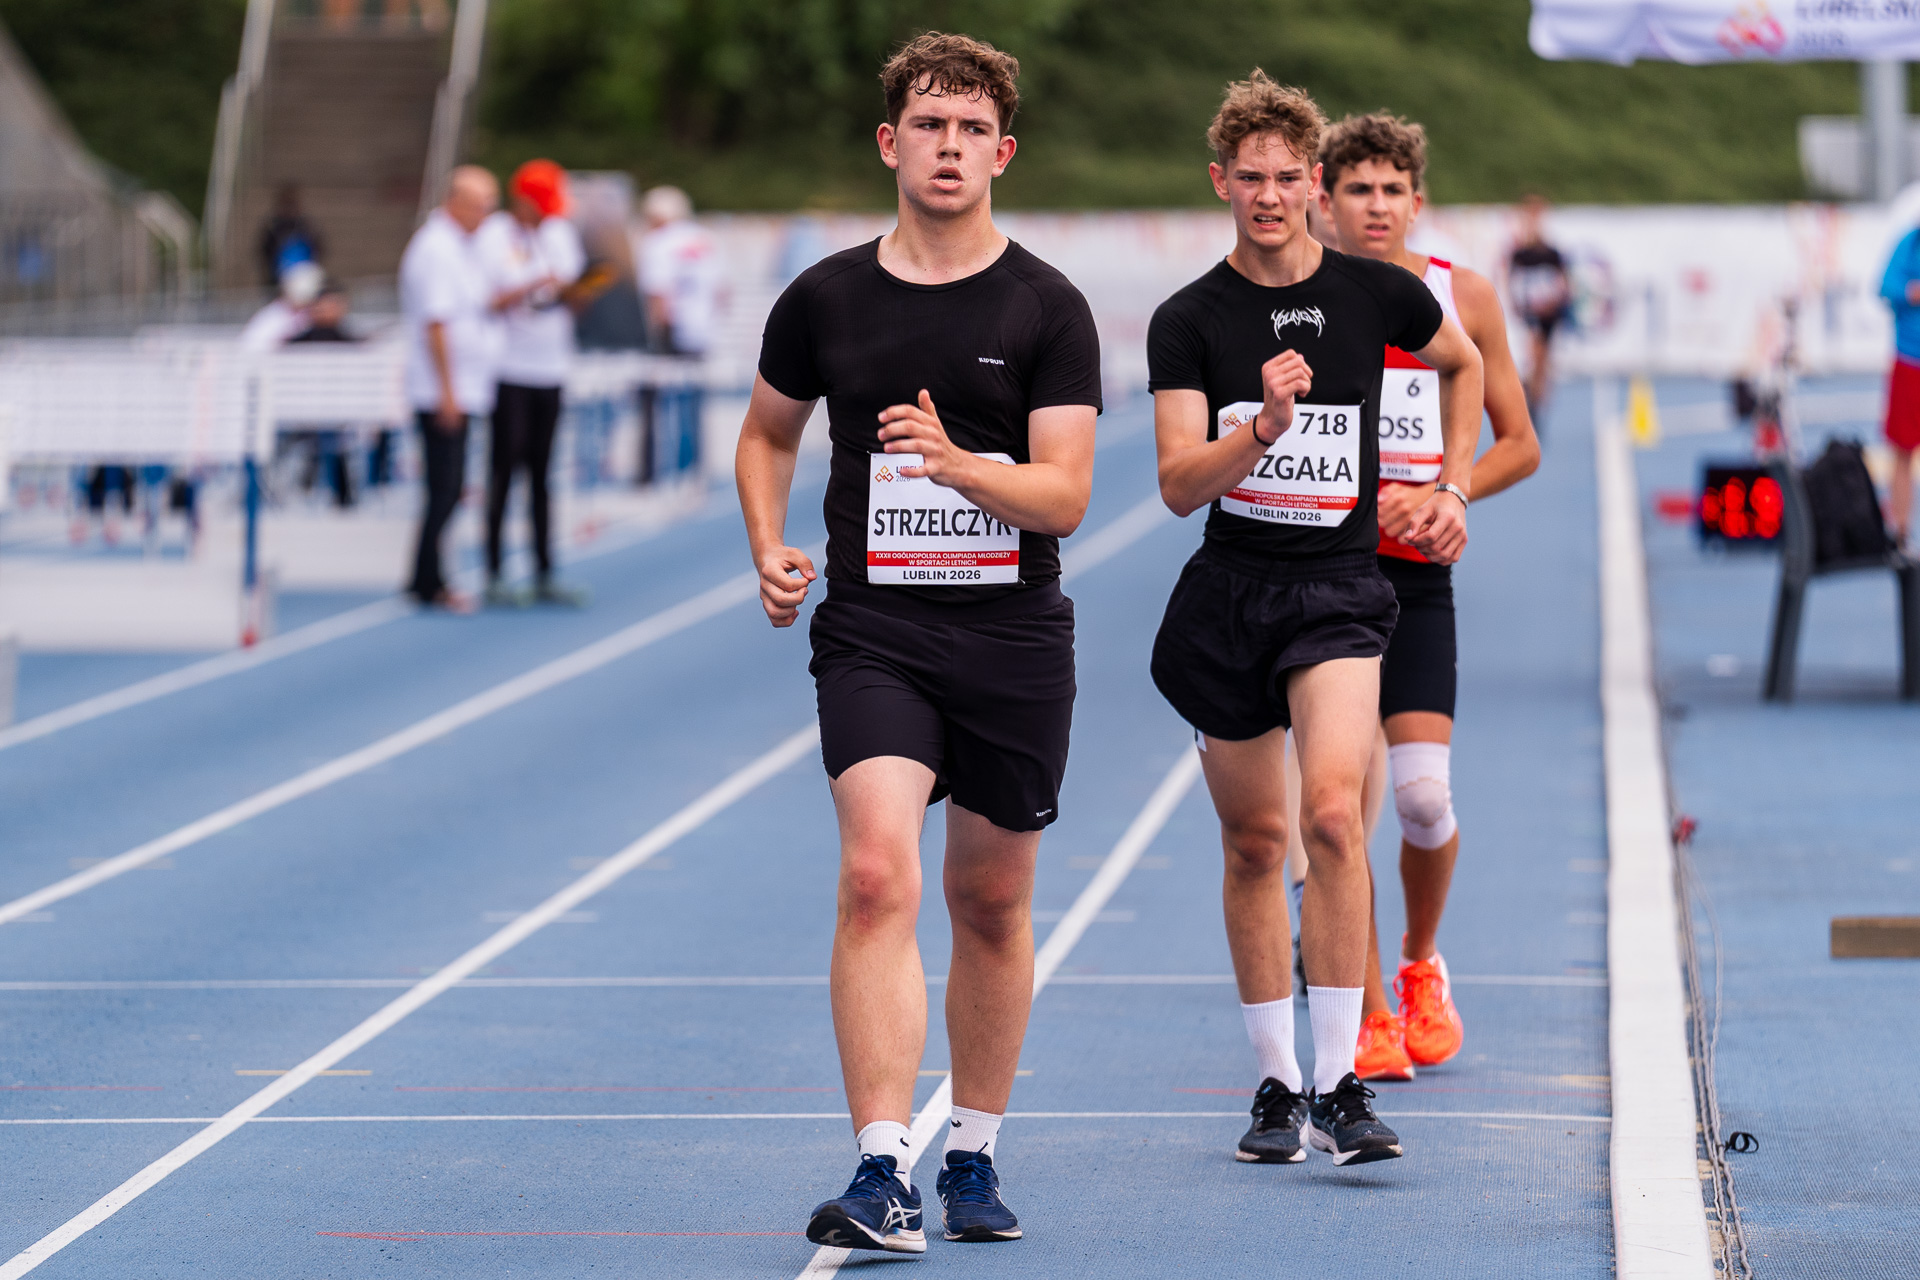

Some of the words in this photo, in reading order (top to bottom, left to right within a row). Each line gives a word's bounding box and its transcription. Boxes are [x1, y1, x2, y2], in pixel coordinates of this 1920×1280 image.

[1407, 378, 1421, 397] 6
[1299, 412, 1348, 435] 718
[1240, 489, 1285, 501] OGÓLNOPOLSKA
[1286, 495, 1318, 503] OLIMPIADA
[1262, 499, 1294, 507] SPORTACH
[1249, 506, 1289, 520] LUBLIN
[1292, 512, 1322, 522] 2026
[892, 551, 942, 560] OGÓLNOPOLSKA
[942, 552, 976, 560] OLIMPIADA
[977, 551, 1011, 559] MŁODZIEŻY
[903, 570, 946, 580] LUBLIN
[949, 570, 981, 580] 2026
